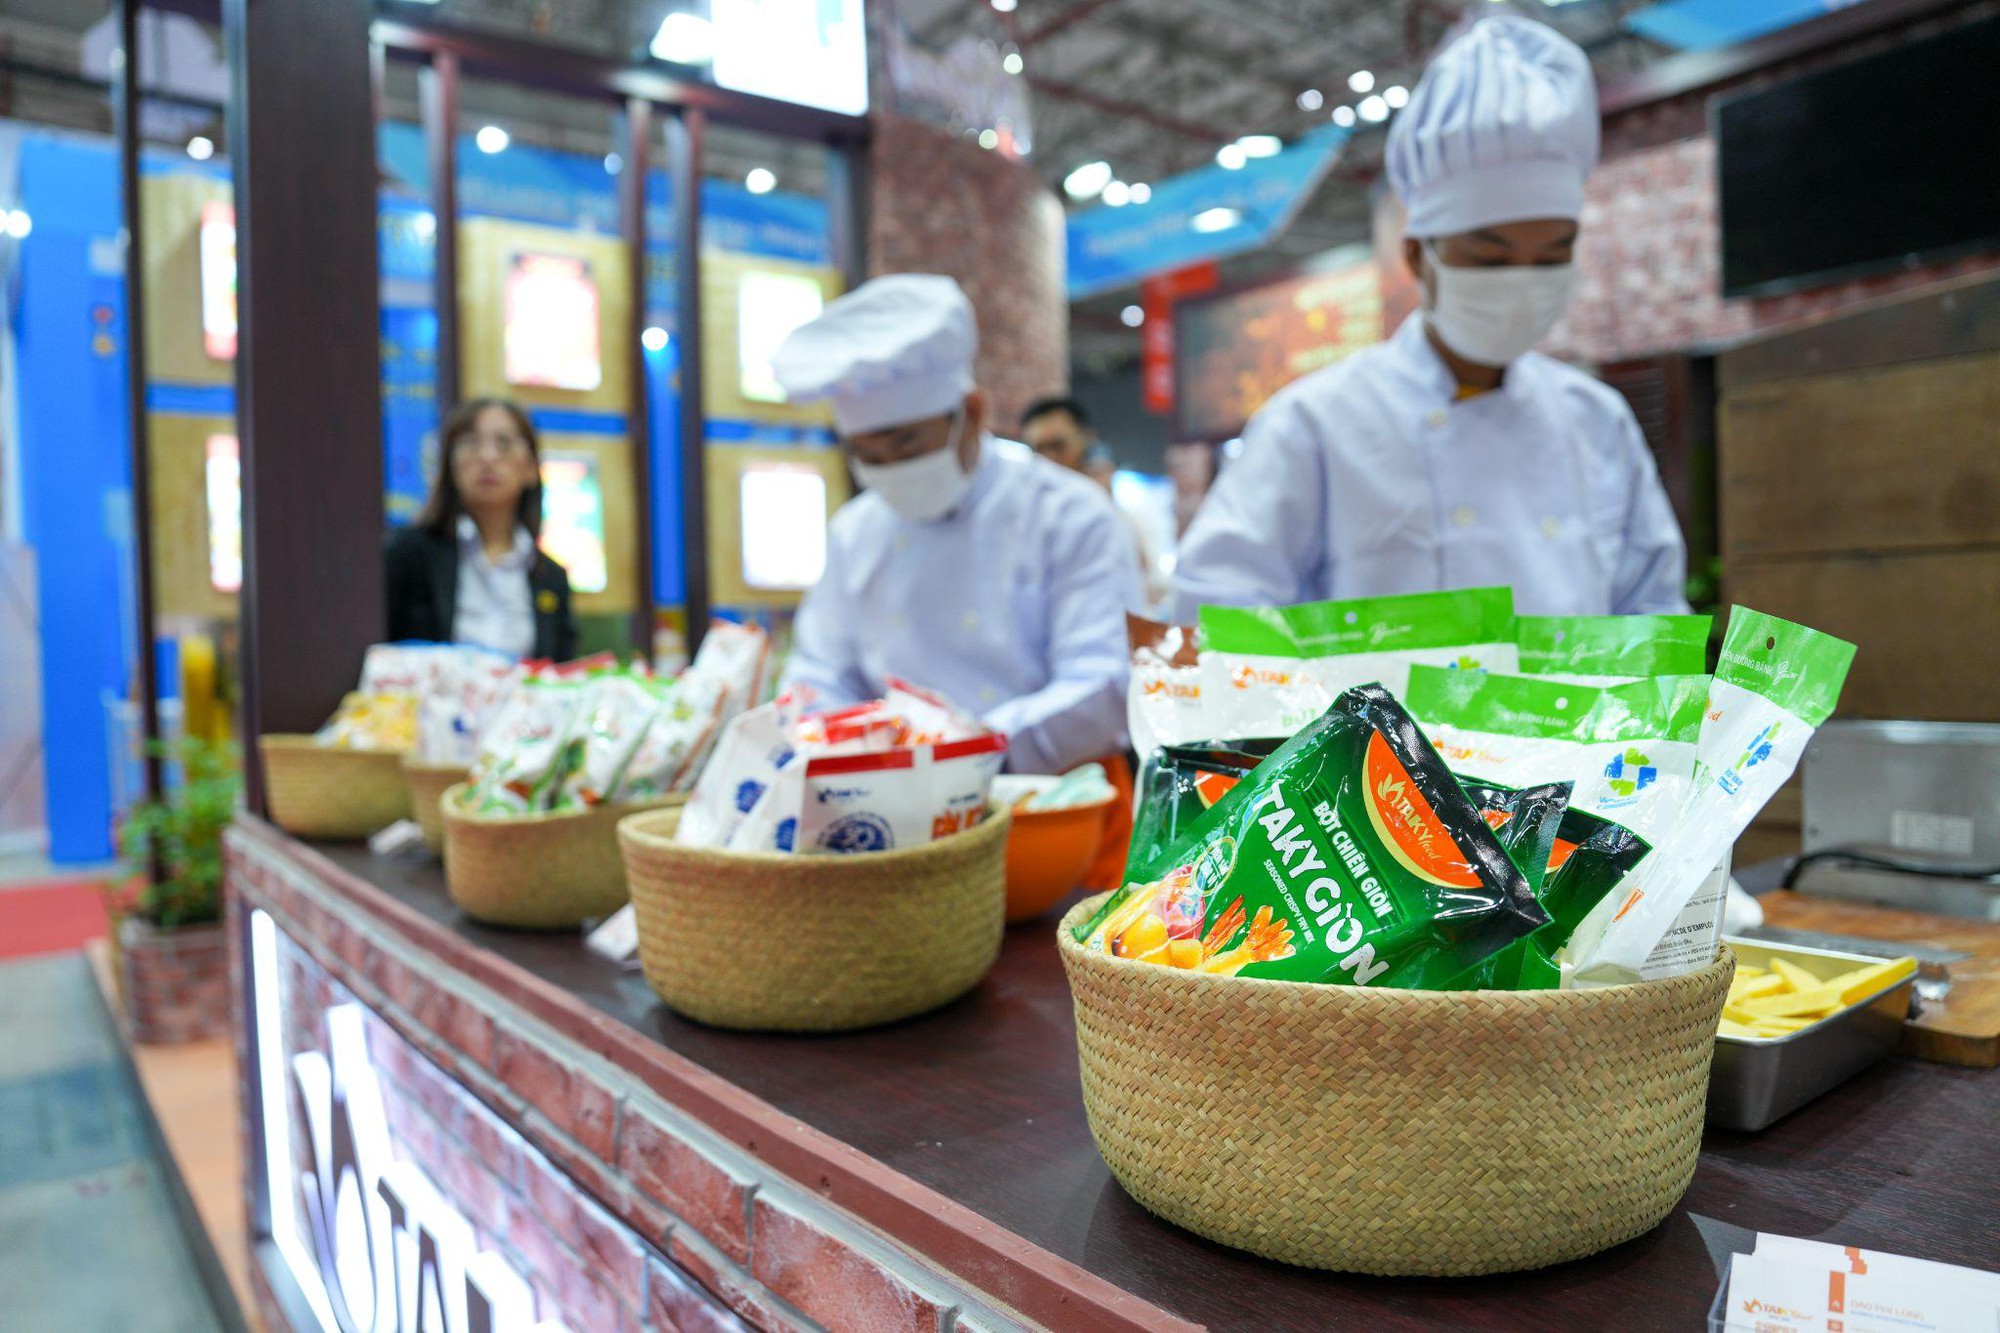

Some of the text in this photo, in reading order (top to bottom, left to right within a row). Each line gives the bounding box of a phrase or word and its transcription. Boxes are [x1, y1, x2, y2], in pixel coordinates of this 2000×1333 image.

[1253, 779, 1326, 879] TAKY
[1313, 800, 1394, 918] BỘT CHIÊN GIÒN
[1264, 859, 1288, 894] SEASONED
[1284, 893, 1302, 918] CRISPY
[1297, 916, 1309, 931] FRY
